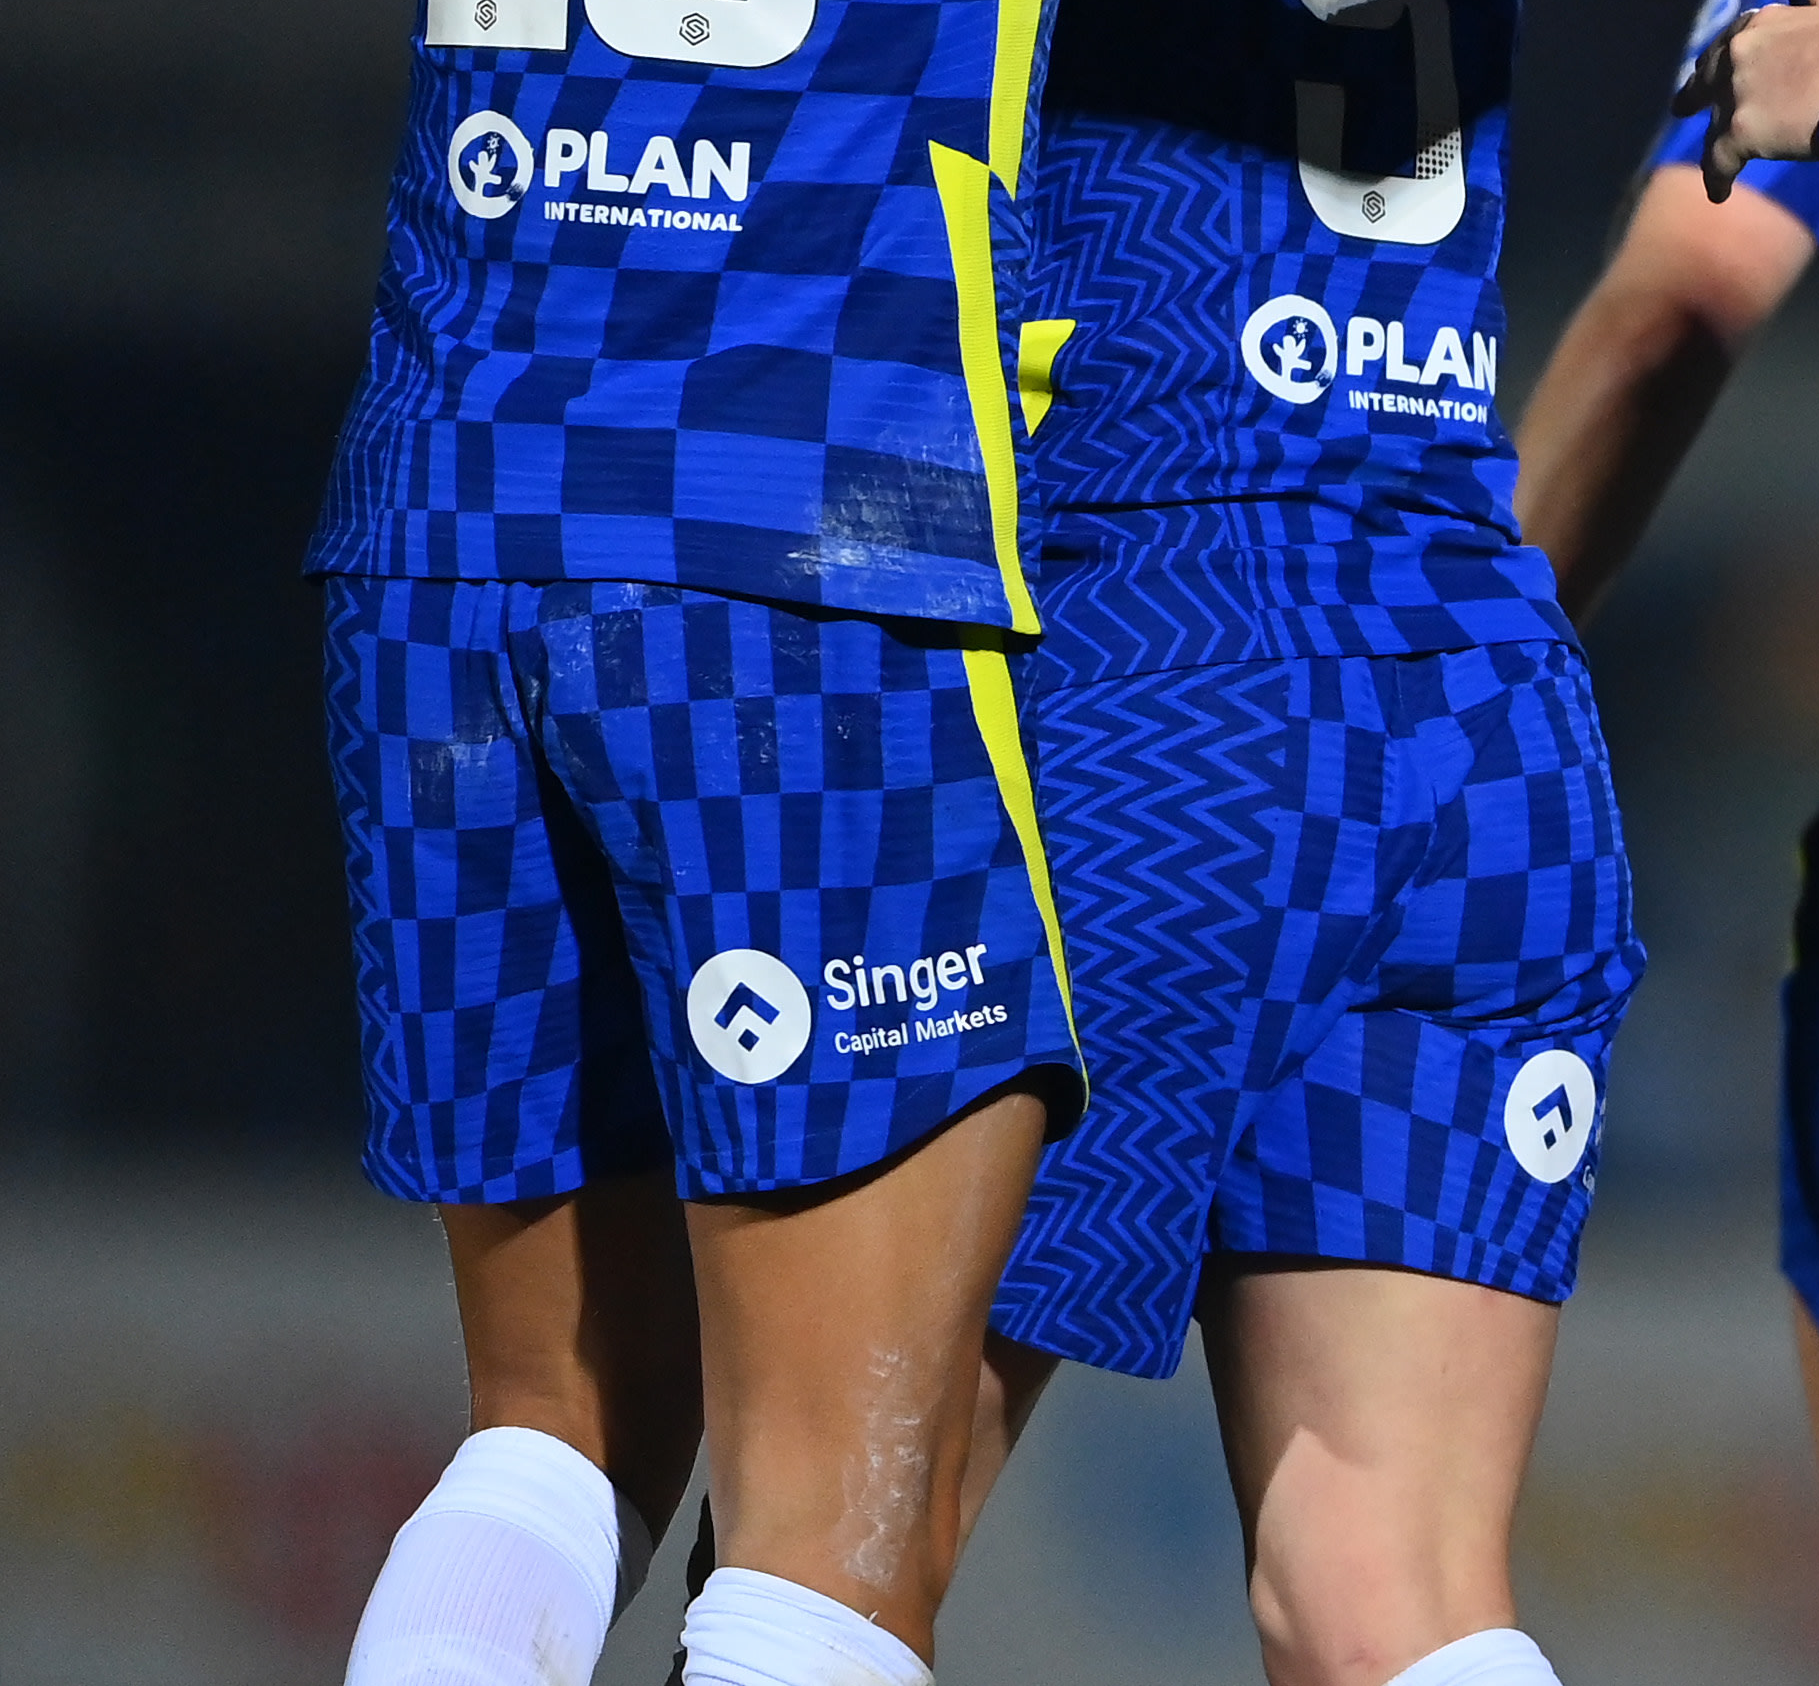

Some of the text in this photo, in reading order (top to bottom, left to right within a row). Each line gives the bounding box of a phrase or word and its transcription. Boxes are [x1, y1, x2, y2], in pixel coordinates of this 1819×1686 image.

[543, 128, 752, 202] PLAN
[544, 201, 743, 232] INTERNATIONAL
[1346, 316, 1496, 397] PLAN
[824, 942, 988, 1012] Singer
[834, 1004, 1008, 1056] Capital Markets
